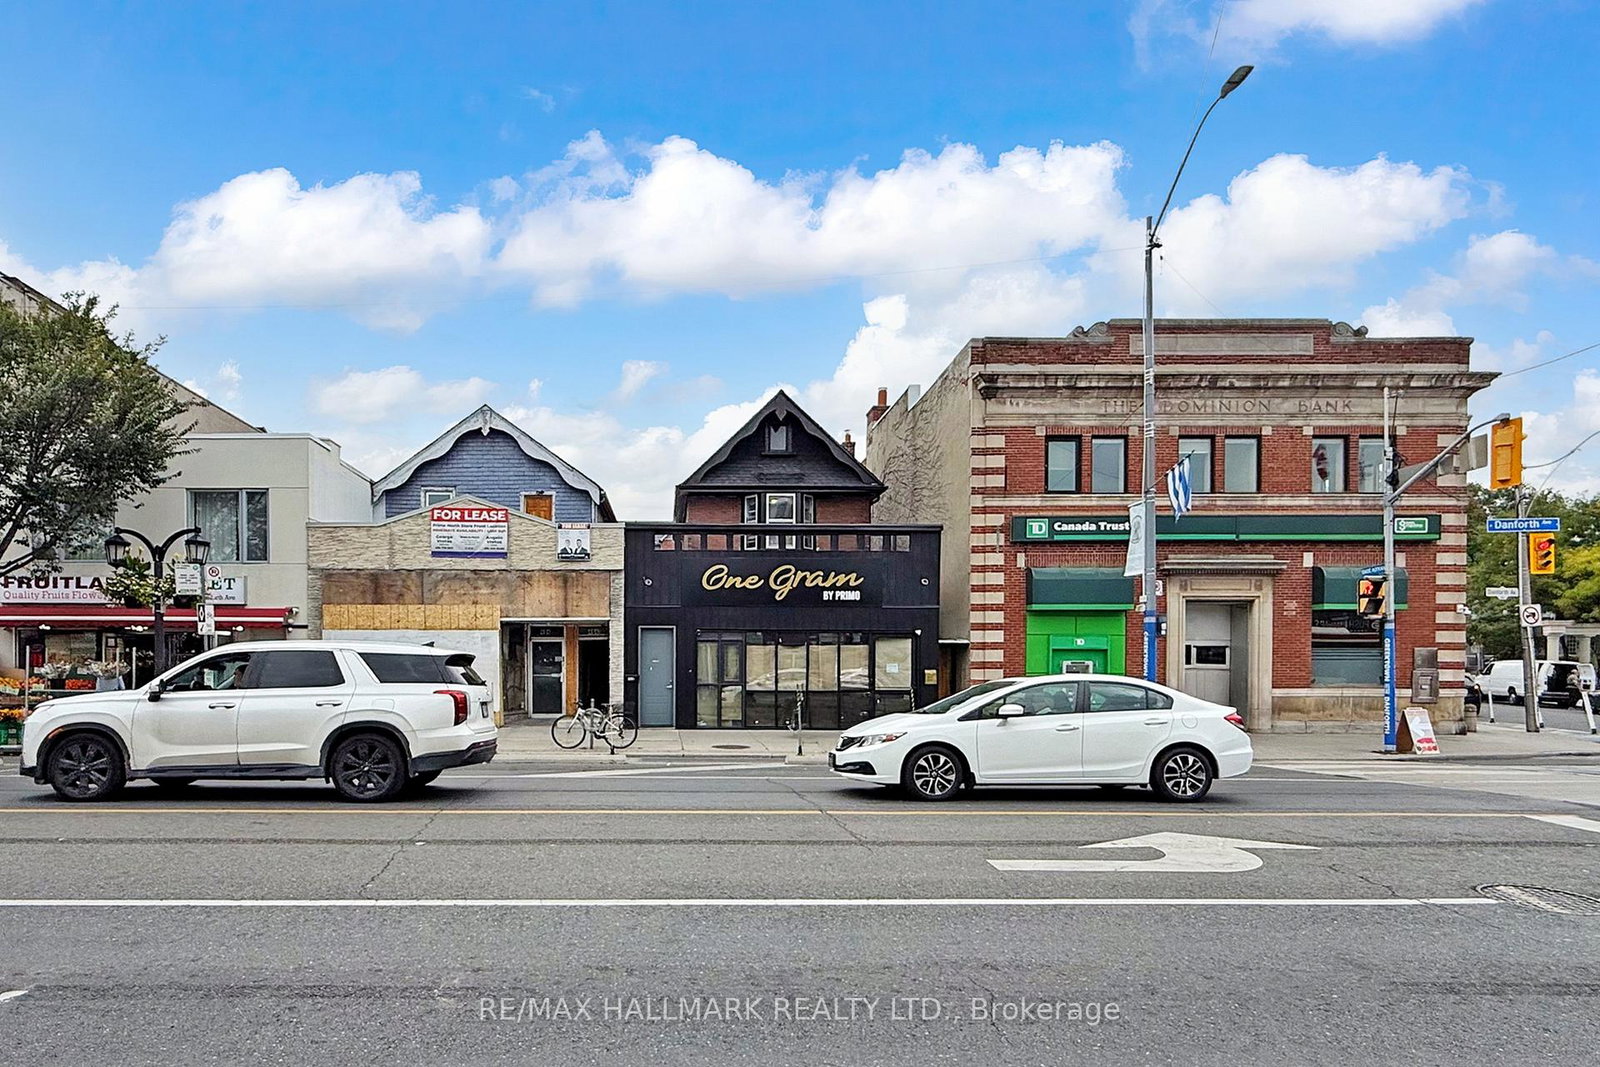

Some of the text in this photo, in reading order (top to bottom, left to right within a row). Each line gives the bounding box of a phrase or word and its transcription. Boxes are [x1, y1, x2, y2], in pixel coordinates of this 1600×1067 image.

[1100, 400, 1353, 413] THE DOMINION BANK
[433, 509, 506, 520] FOR LEASE
[1028, 521, 1130, 534] TD Canada Trust
[1494, 520, 1540, 529] Danforth
[3, 576, 104, 589] FRUITLA
[701, 564, 865, 601] One Gram
[3, 590, 40, 600] Quality
[42, 590, 70, 600] Fruits
[822, 590, 861, 601] BY PRIMO
[1073, 638, 1085, 646] TD
